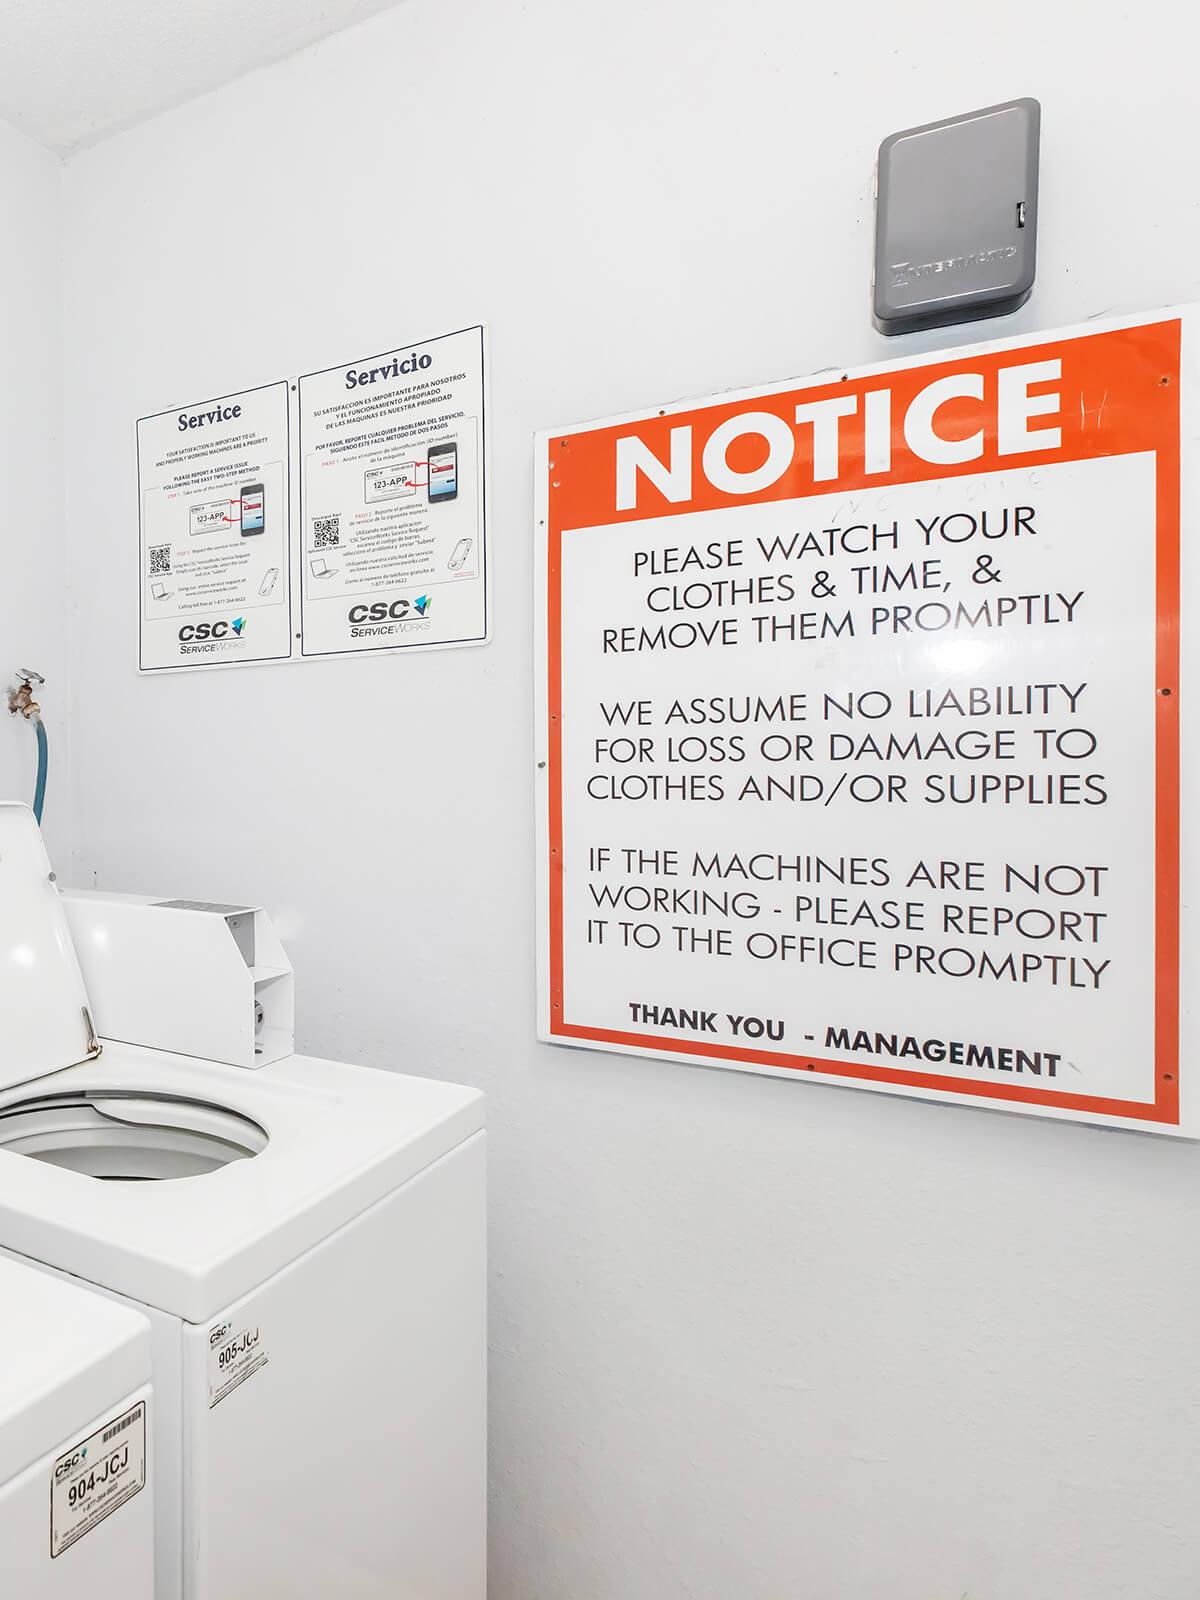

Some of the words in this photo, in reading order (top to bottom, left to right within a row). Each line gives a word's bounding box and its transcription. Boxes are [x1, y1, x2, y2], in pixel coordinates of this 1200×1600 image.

[345, 355, 432, 389] Servicio
[178, 405, 241, 431] Service
[614, 357, 1063, 512] NOTICE
[373, 476, 408, 489] 123-APP
[197, 511, 224, 523] 123-APP
[632, 540, 743, 576] PLEASE
[757, 522, 901, 561] WATCH
[916, 506, 1038, 545] YOUR
[646, 574, 795, 612] CLOTHES
[810, 570, 837, 599] &
[851, 560, 951, 594] TIME,
[971, 555, 1002, 585] &
[178, 621, 228, 642] CSC
[348, 600, 410, 623] CSC
[600, 619, 738, 653] REMOVE
[751, 611, 855, 642] THEM
[871, 592, 1084, 634] PROMPTLY
[599, 700, 653, 726] WE
[664, 694, 807, 725] ASSUME
[823, 691, 892, 720] NO
[906, 683, 1086, 718] LIABILITY
[595, 738, 655, 763] FOR
[667, 736, 746, 763] LOSS
[760, 734, 814, 762] OR
[829, 730, 1016, 761] DAMAGE
[1033, 728, 1098, 760] TO
[586, 775, 725, 801] CLOTHES
[738, 774, 909, 805] AND/OR
[924, 774, 1110, 805] SUPPLIES
[589, 847, 611, 872] IF
[621, 848, 678, 876] THE
[692, 853, 890, 886] MACHINES
[905, 861, 985, 891] ARE
[1002, 864, 1110, 897] NOT
[588, 884, 761, 919] WORKING
[793, 896, 925, 931] PLEASE
[939, 904, 1108, 942] REPORT
[587, 919, 608, 945] IT
[619, 922, 661, 949] TO
[672, 926, 733, 956] THE
[746, 932, 877, 969] OFFICE
[891, 944, 1111, 988] PROMPTLY
[628, 1003, 718, 1033] THANK
[726, 1014, 785, 1041] YOU
[824, 1028, 1062, 1076] MANAGEMENT
[55, 1453, 80, 1478] CSC
[68, 1447, 129, 1507] 904-JCJ
